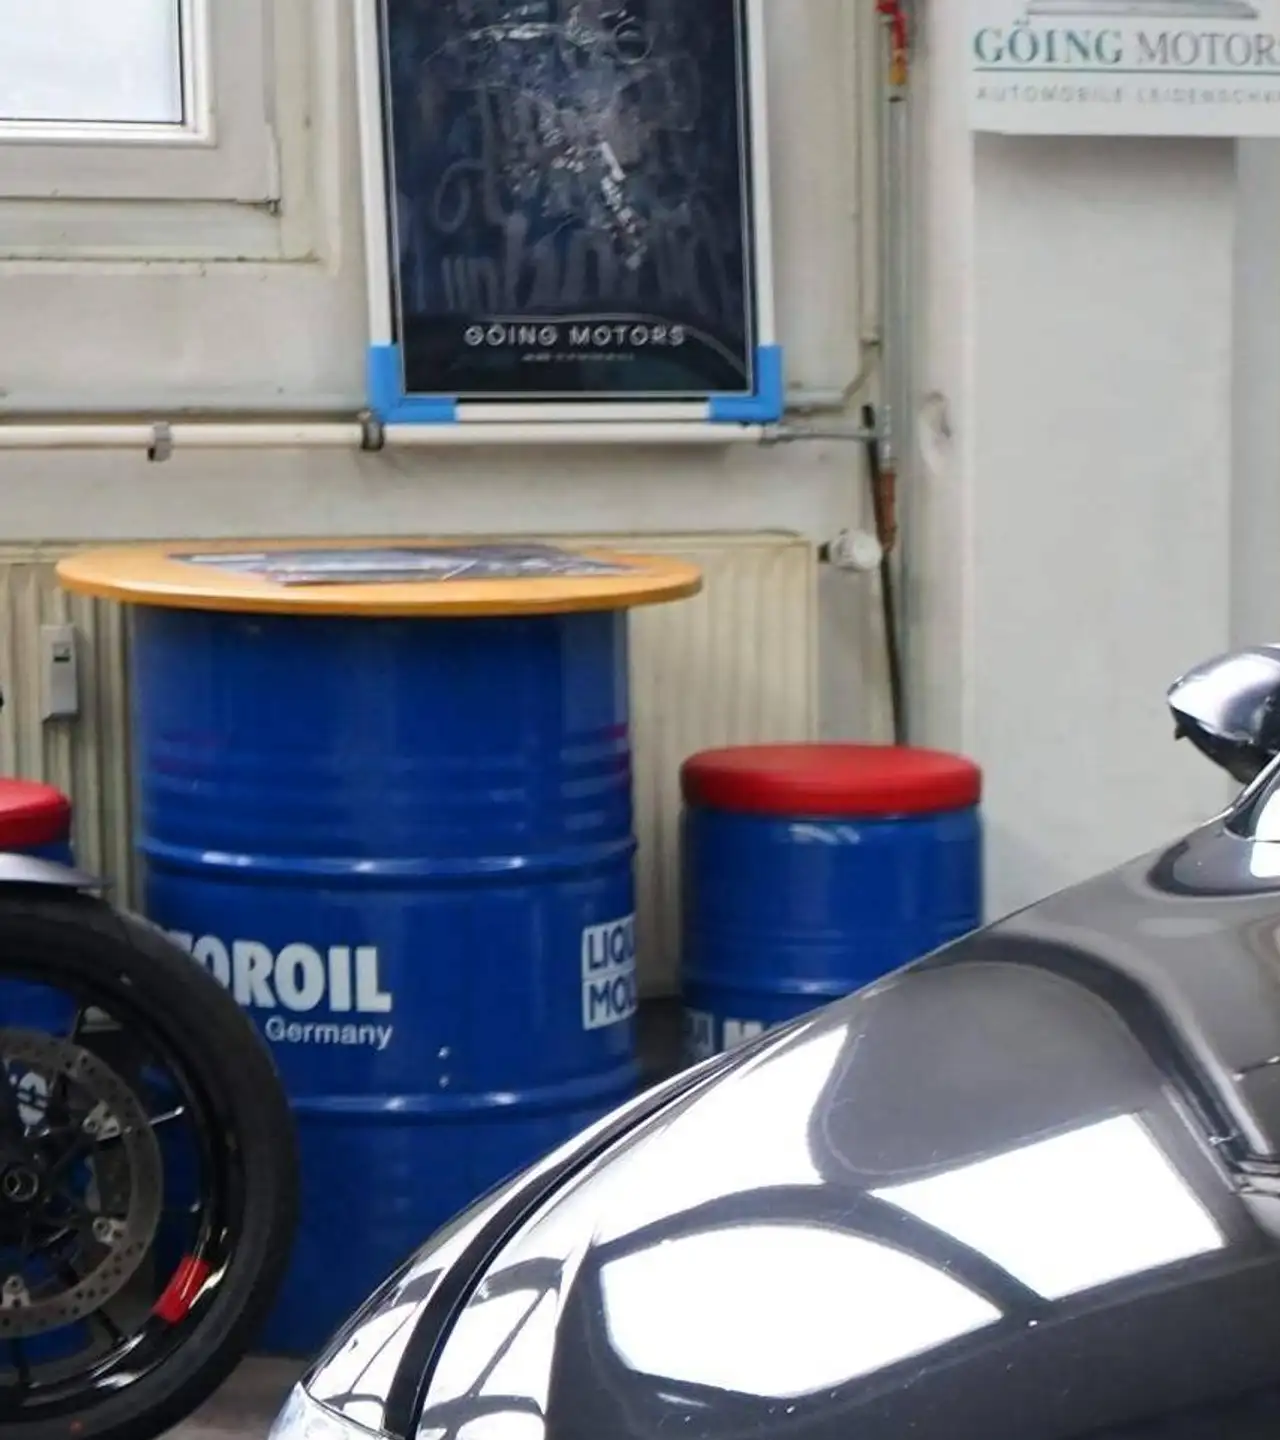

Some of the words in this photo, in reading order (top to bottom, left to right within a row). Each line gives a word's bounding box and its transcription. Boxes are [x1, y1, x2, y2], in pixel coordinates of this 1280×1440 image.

[974, 20, 1123, 64] GÖING
[569, 323, 685, 347] MOTORS
[265, 1015, 393, 1050] Germany
